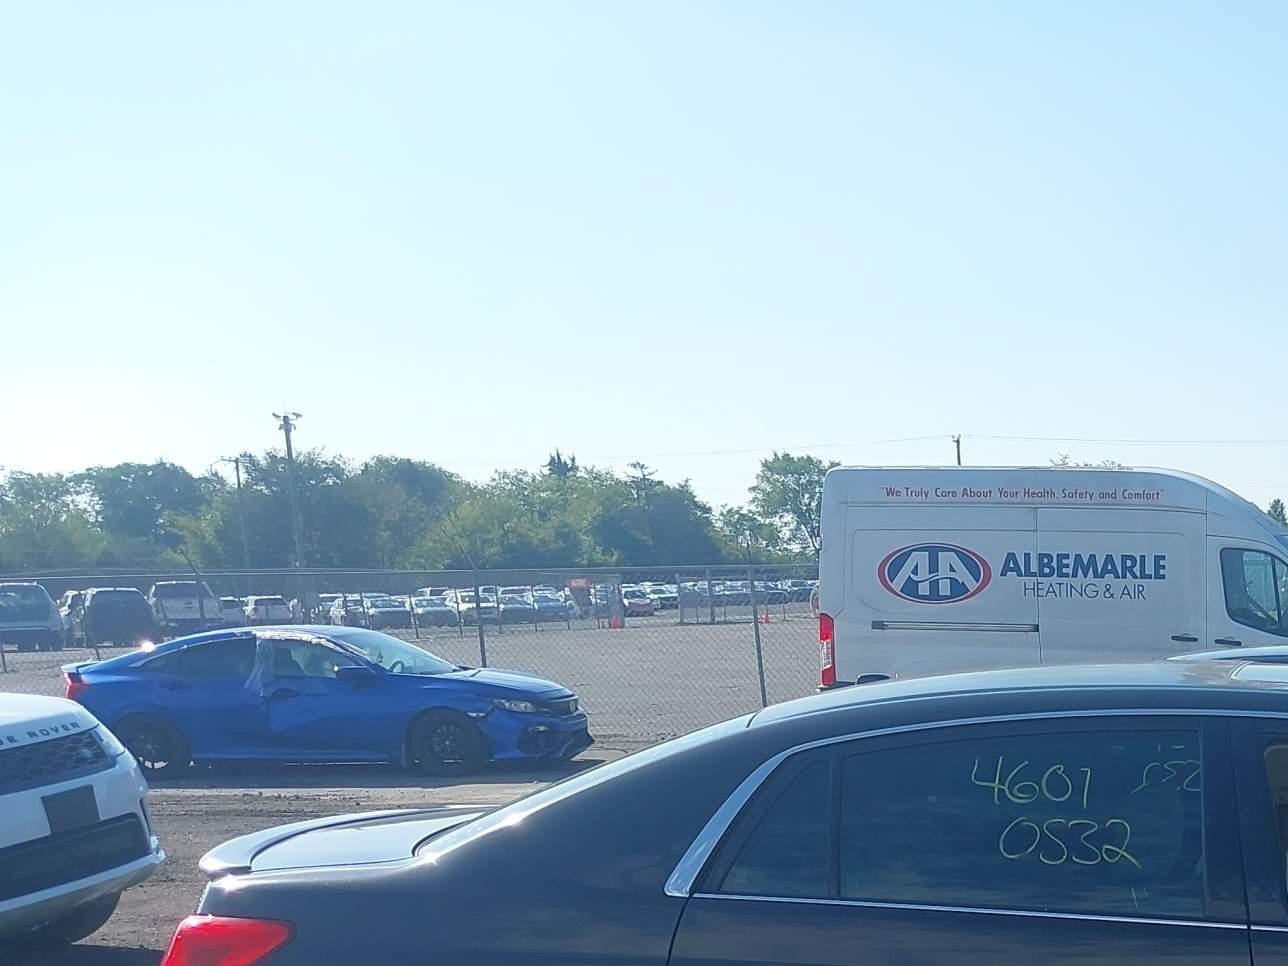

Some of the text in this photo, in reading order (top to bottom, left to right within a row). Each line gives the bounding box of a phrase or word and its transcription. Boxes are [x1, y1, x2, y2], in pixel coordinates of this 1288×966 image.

[903, 486, 930, 500] Truly
[934, 487, 958, 498] Care
[960, 487, 993, 499] About
[997, 487, 1020, 499] Your
[1061, 488, 1094, 501] Safety
[1099, 488, 1117, 500] and
[1000, 552, 1167, 580] ALBEMARLE
[1023, 581, 1146, 600] HEATING & AIR
[26, 721, 81, 739] ROVER
[999, 817, 1142, 870] 0532
